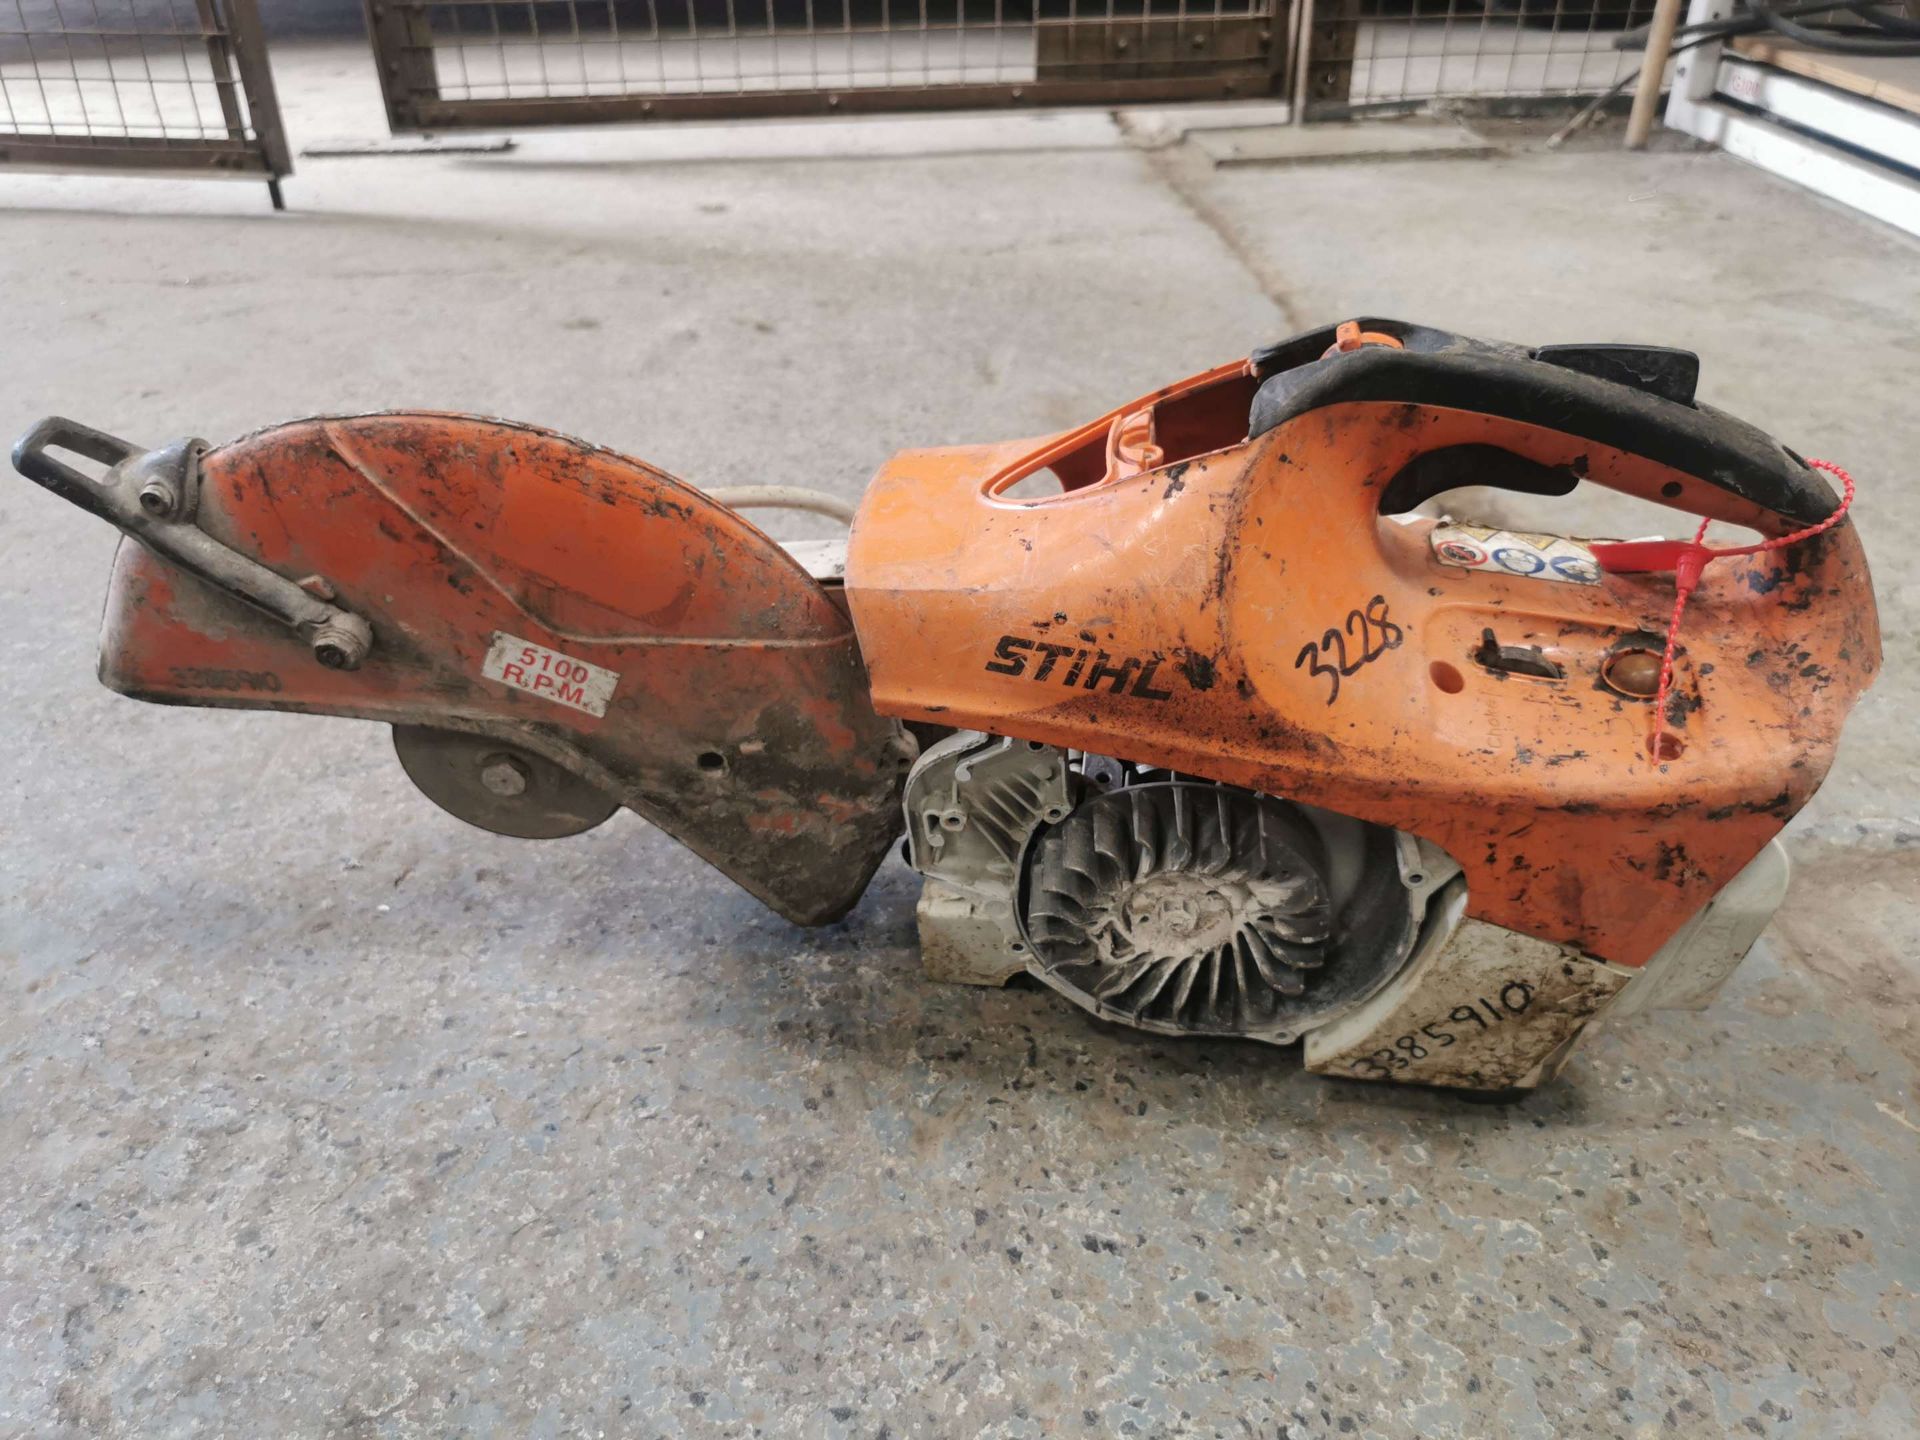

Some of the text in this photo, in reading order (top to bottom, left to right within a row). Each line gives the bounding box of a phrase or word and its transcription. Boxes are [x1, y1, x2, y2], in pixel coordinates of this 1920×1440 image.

[519, 647, 589, 684] 5100
[985, 635, 1172, 701] STIHL
[1295, 594, 1403, 707] 3228
